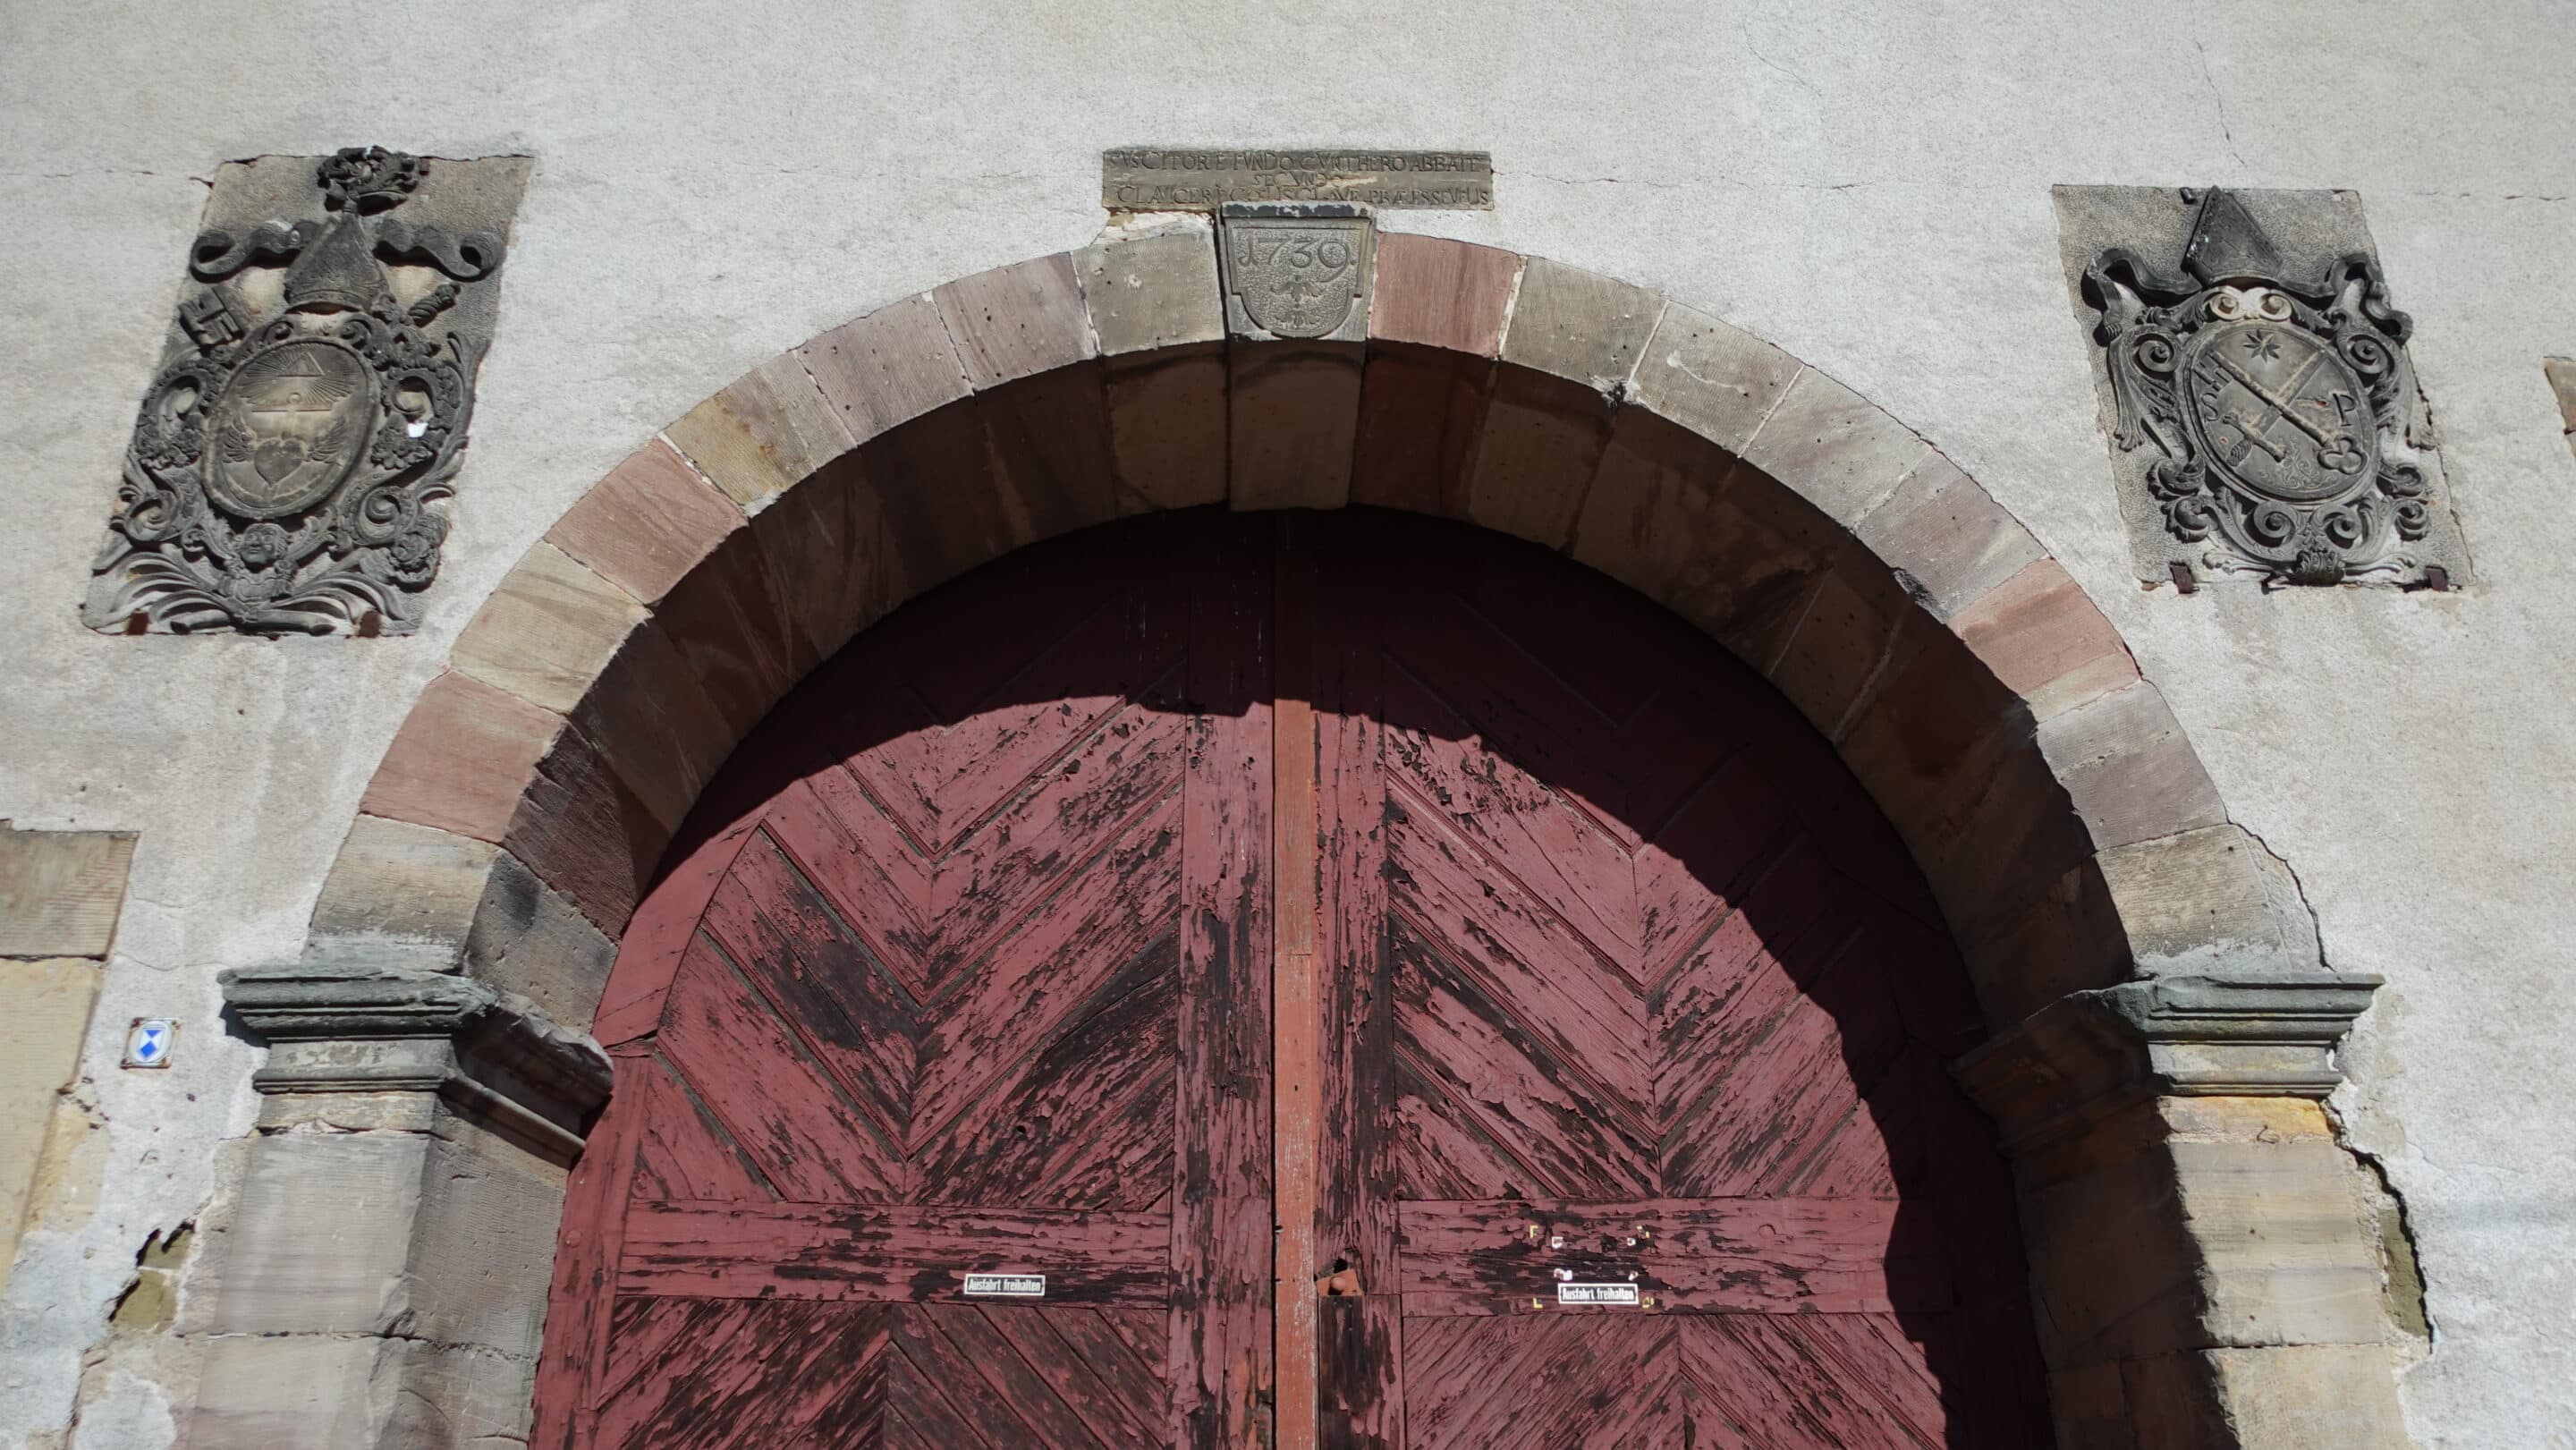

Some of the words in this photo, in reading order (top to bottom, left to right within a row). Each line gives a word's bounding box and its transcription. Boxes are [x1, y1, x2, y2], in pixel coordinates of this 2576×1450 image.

[1410, 155, 1482, 172] ABBATE
[968, 1277, 1001, 1291] Ausfahrt
[1004, 1278, 1041, 1292] freihalten
[1562, 1287, 1595, 1301] Ausfahrt
[1597, 1287, 1634, 1301] freihalten
